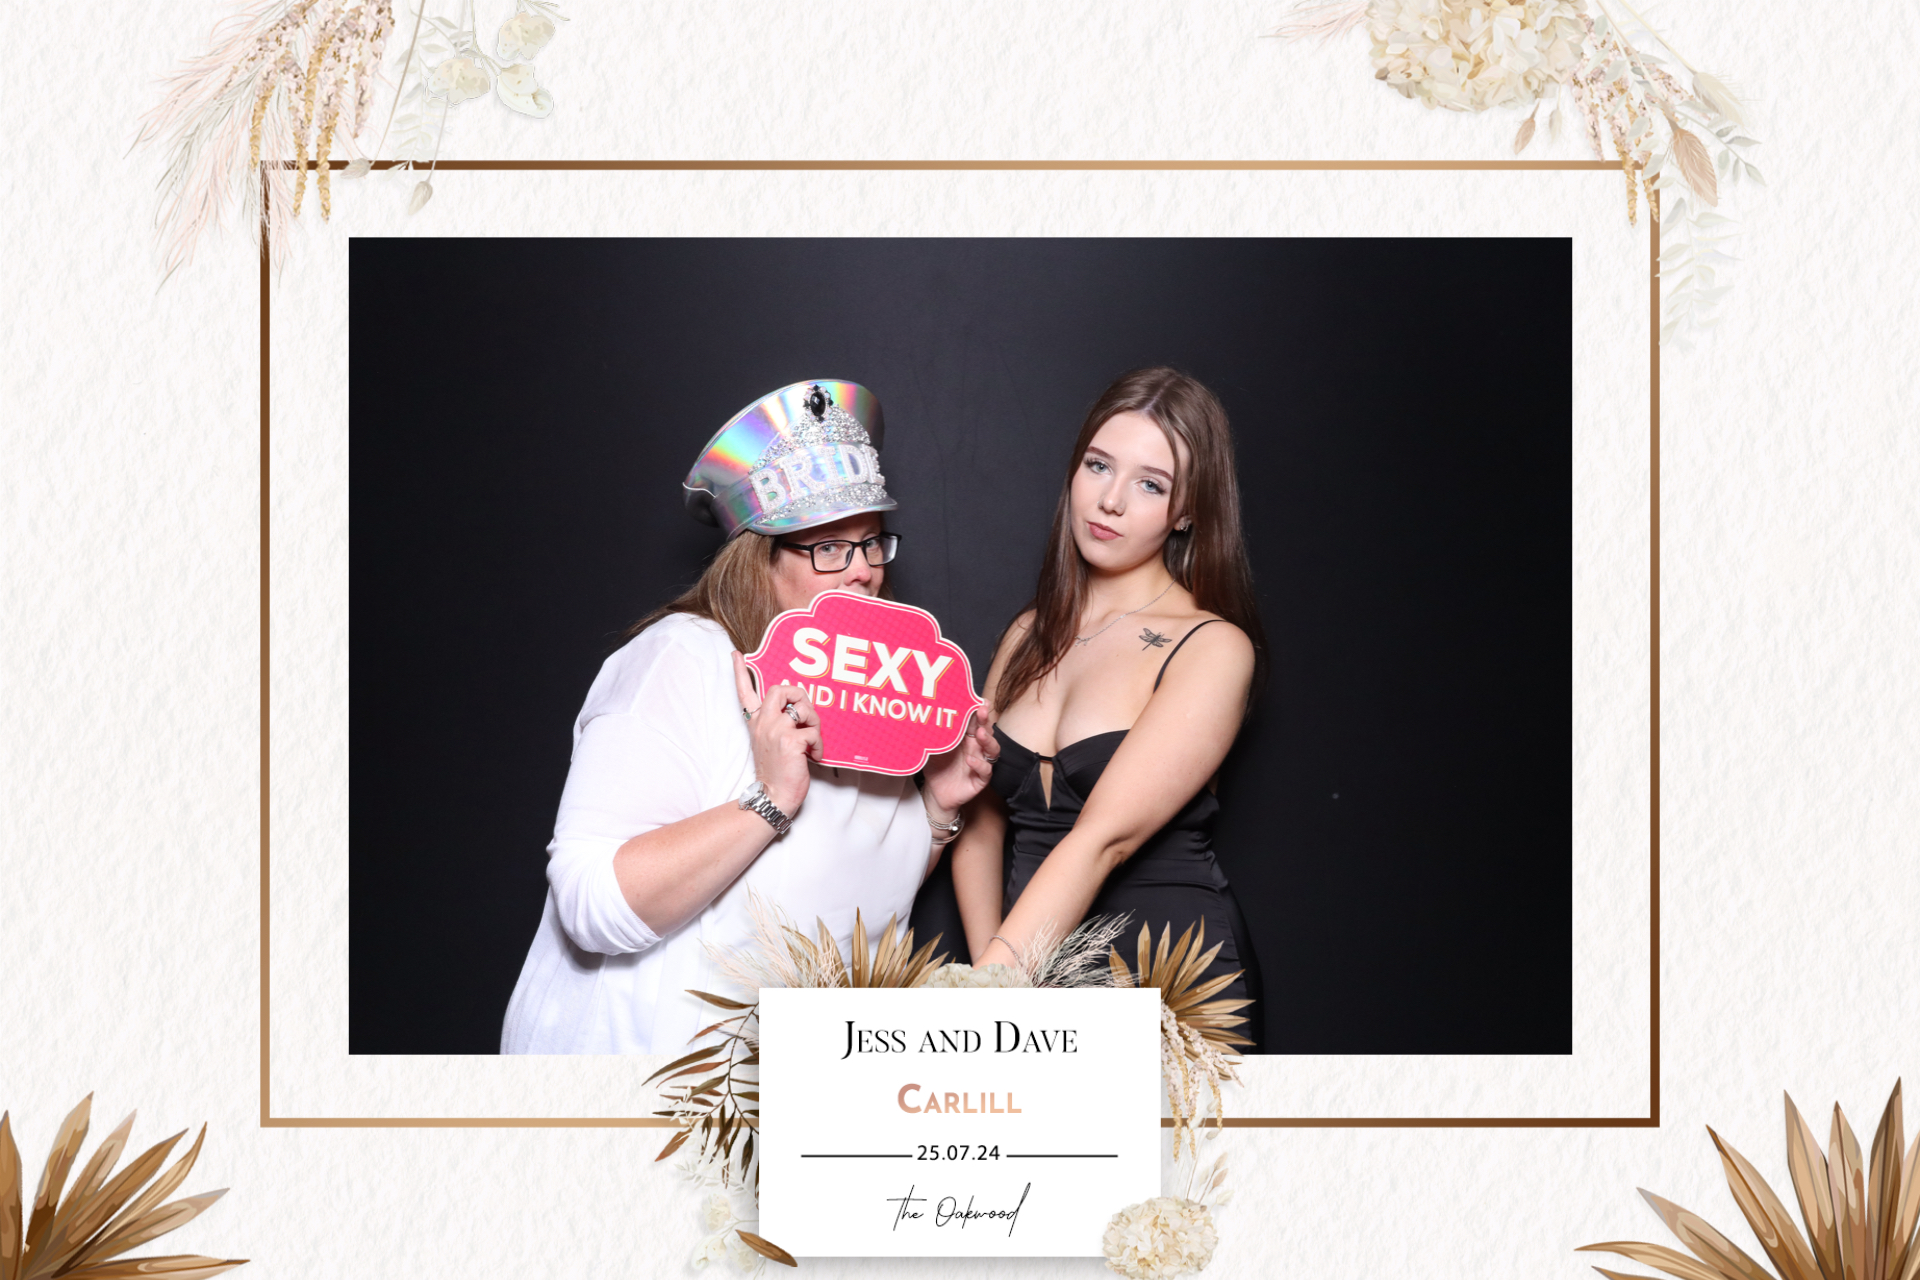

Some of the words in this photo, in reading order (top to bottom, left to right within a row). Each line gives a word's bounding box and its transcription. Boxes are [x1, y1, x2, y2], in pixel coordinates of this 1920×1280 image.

[789, 627, 954, 699] SEXY
[780, 679, 835, 708] ND
[839, 690, 848, 711] I
[853, 692, 932, 724] KNOW
[936, 707, 957, 728] IT
